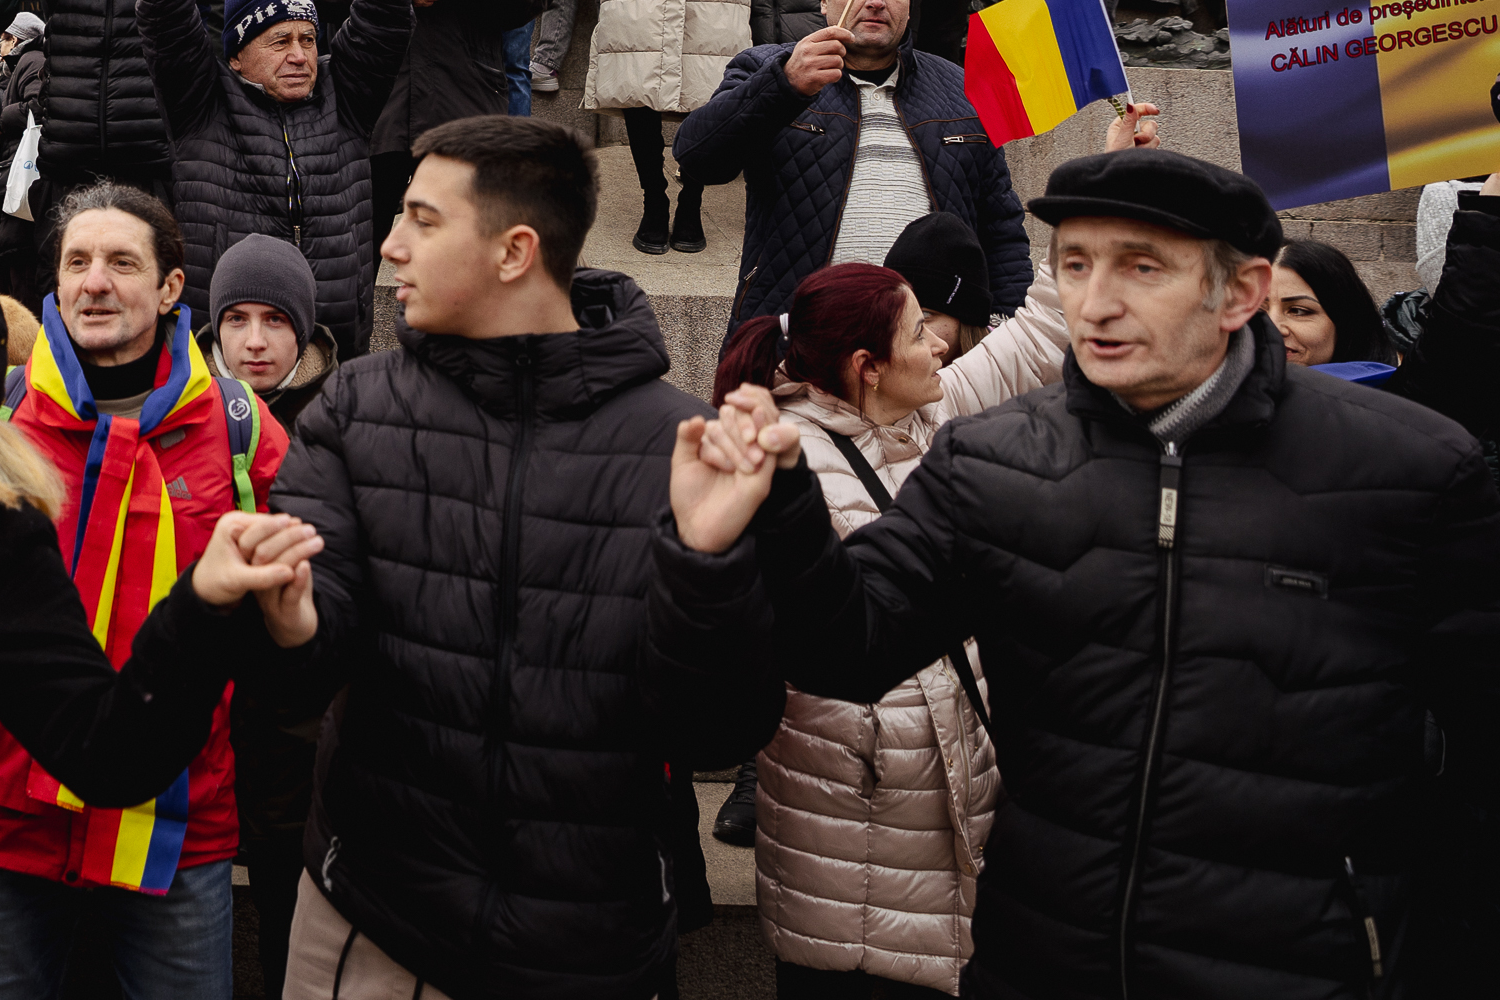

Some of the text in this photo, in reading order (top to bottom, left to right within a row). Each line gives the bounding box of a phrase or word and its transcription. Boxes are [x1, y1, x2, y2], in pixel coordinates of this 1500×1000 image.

[1265, 11, 1330, 40] Alături
[1336, 7, 1362, 26] de
[1271, 15, 1499, 72] CĂLIN GEORGESCU
